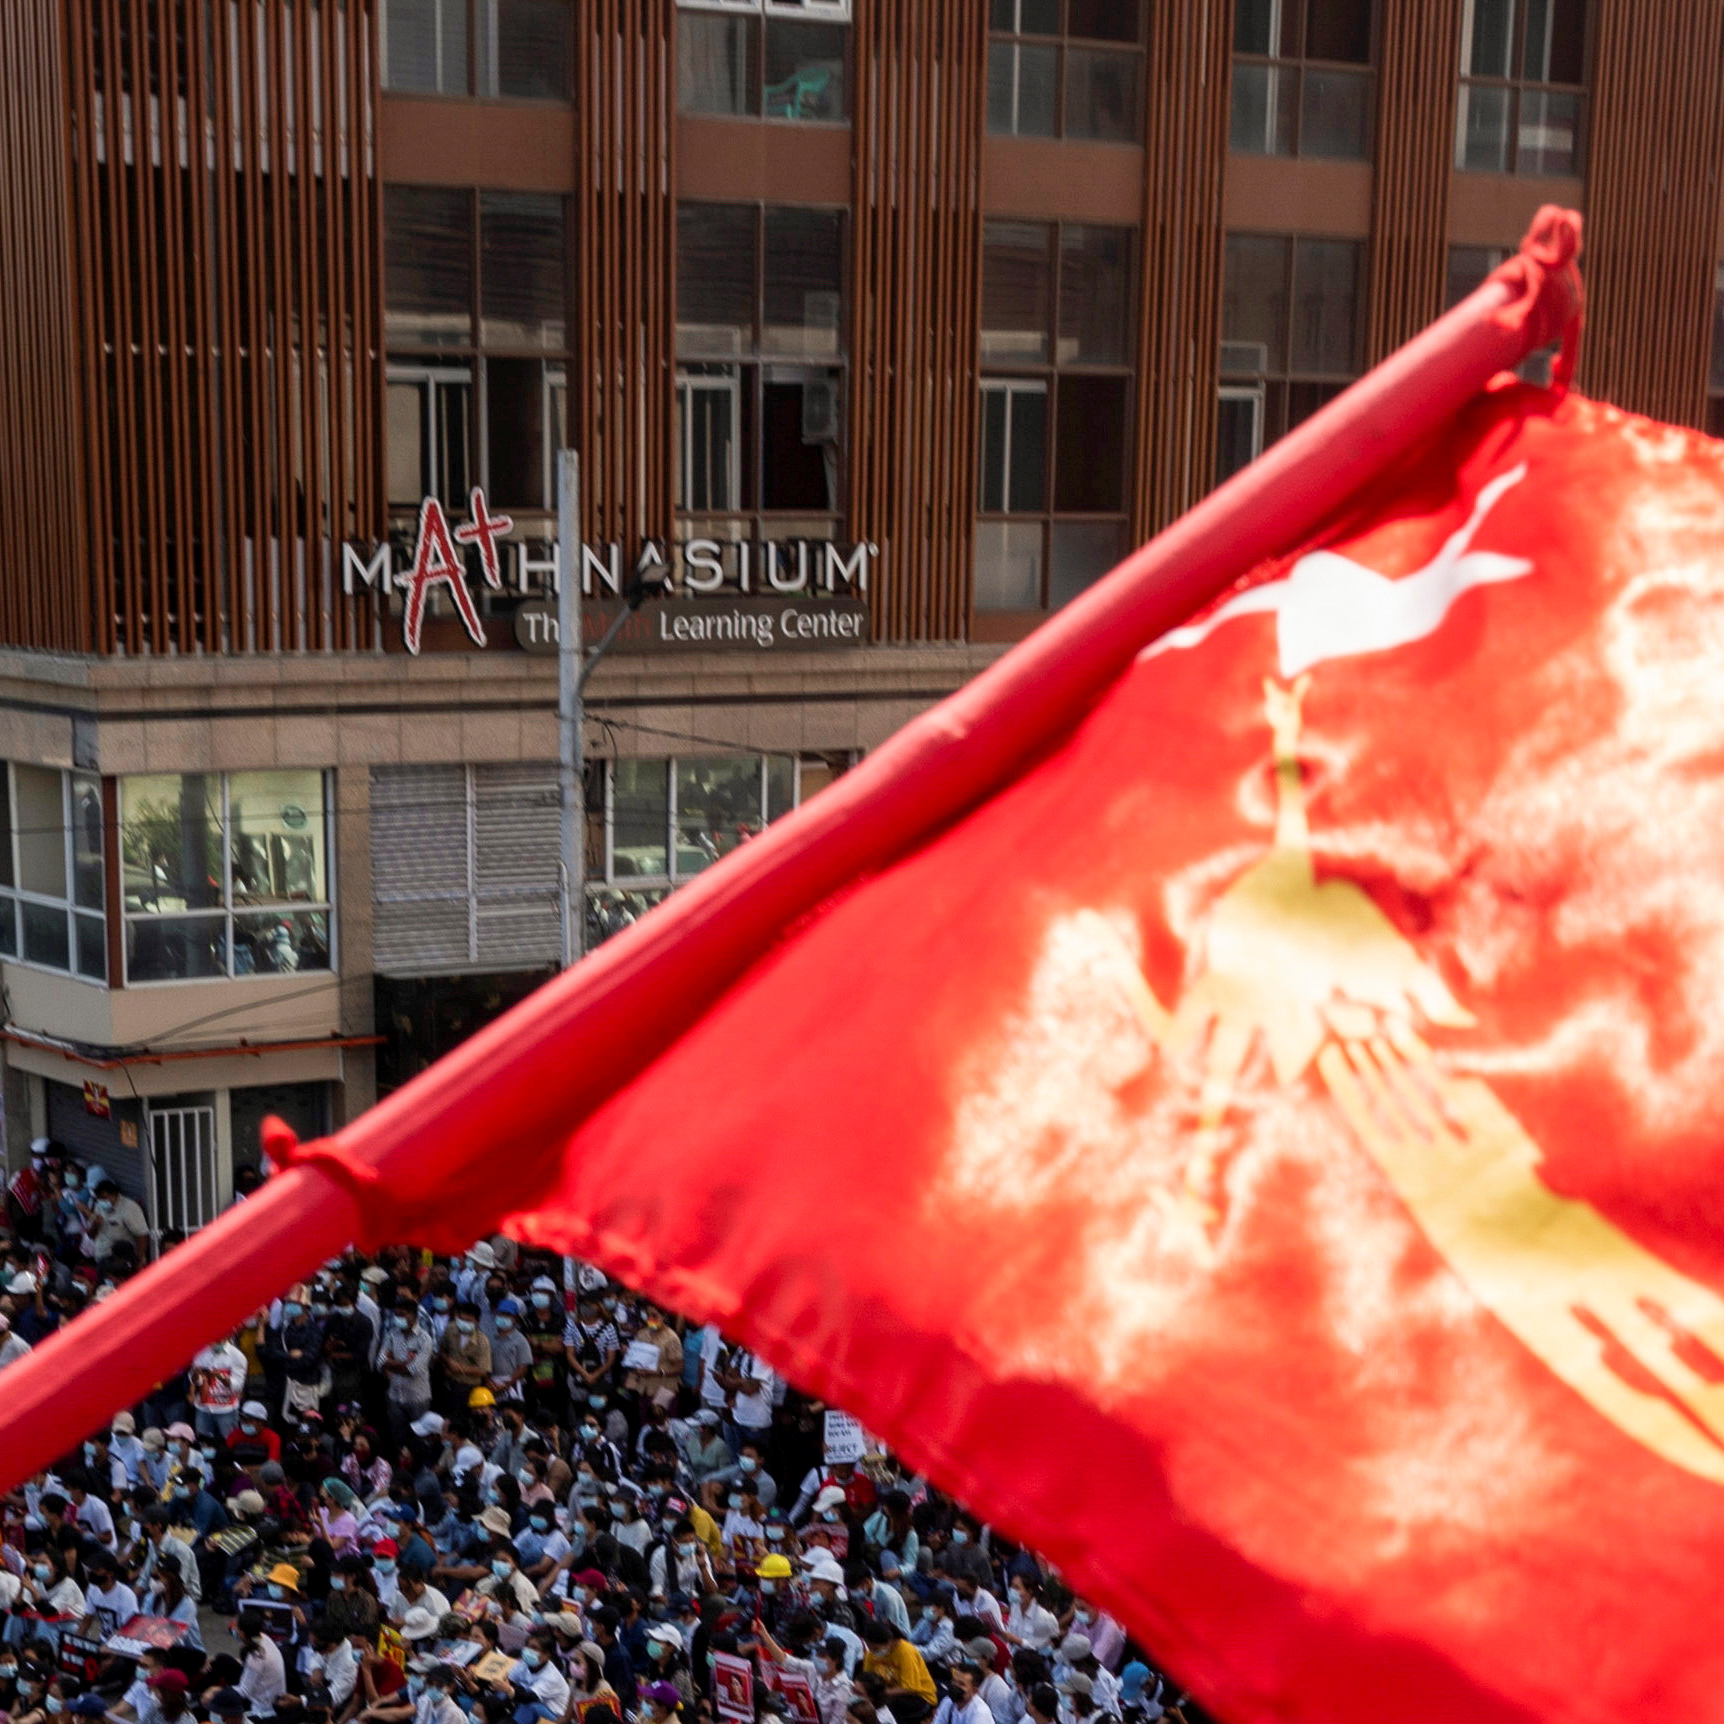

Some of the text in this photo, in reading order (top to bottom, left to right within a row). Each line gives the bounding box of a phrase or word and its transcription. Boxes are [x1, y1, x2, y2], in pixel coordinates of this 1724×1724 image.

[523, 612, 560, 643] Th
[660, 612, 774, 647] Learning
[781, 608, 864, 640] Center
